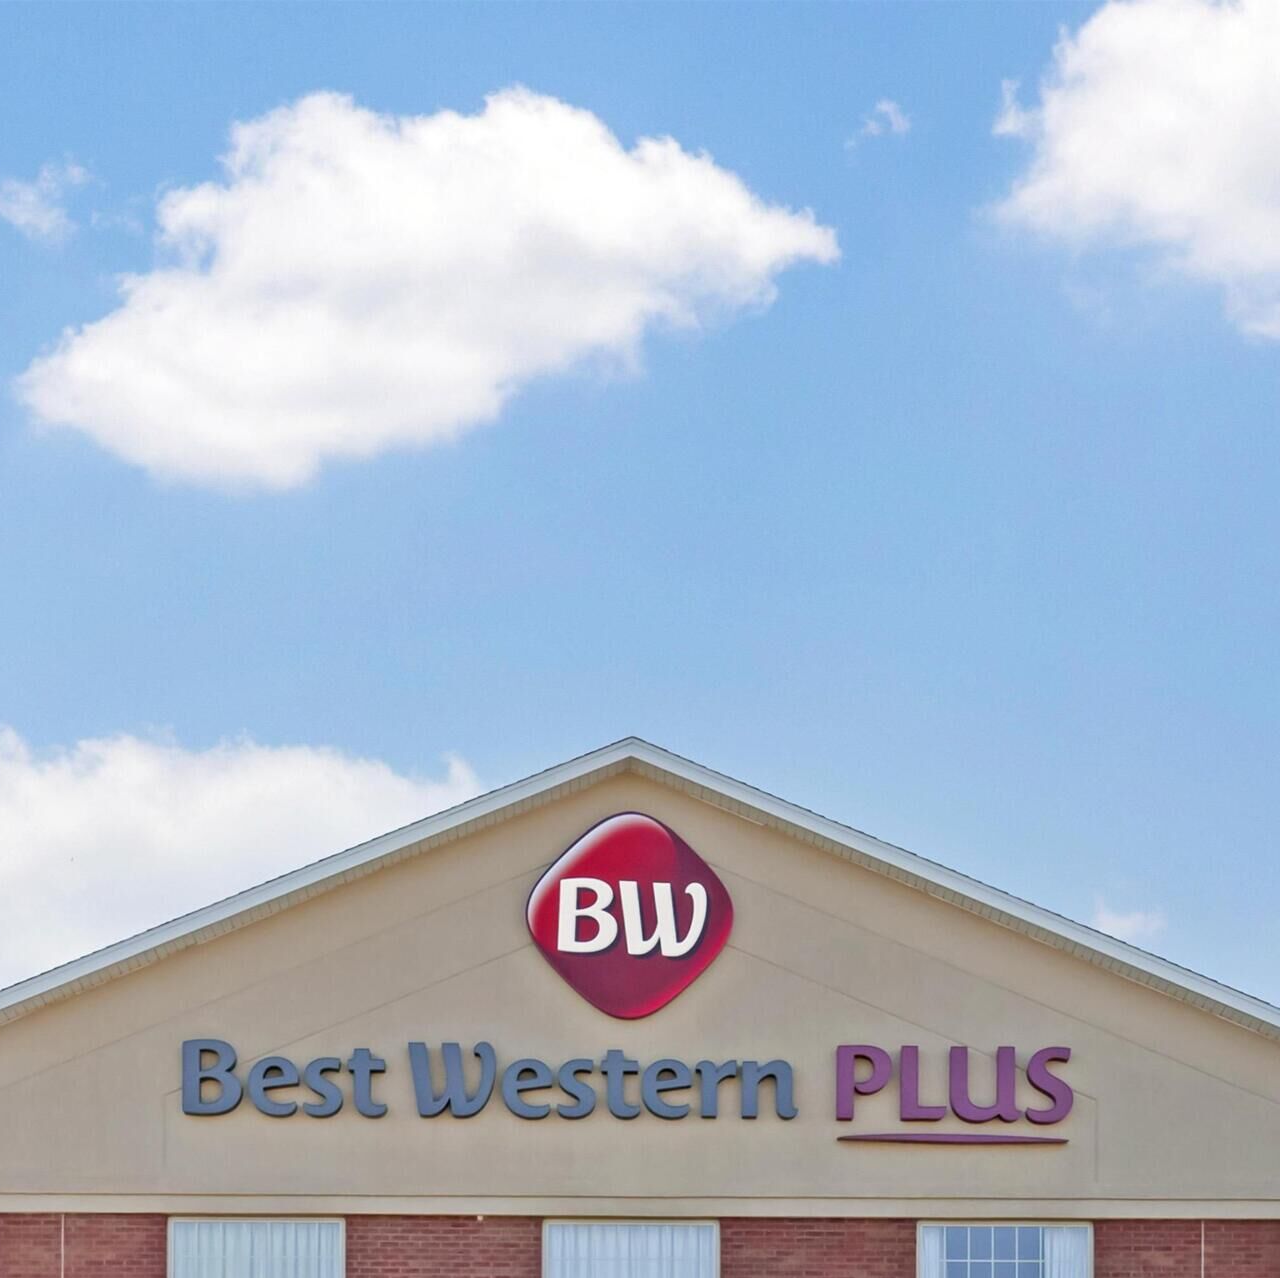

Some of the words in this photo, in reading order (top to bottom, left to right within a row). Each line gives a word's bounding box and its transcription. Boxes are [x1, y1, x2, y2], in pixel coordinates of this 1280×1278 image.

[557, 877, 708, 957] BW
[182, 1039, 388, 1118] Best
[408, 1041, 798, 1121] Western
[835, 1045, 1074, 1125] PLUS
